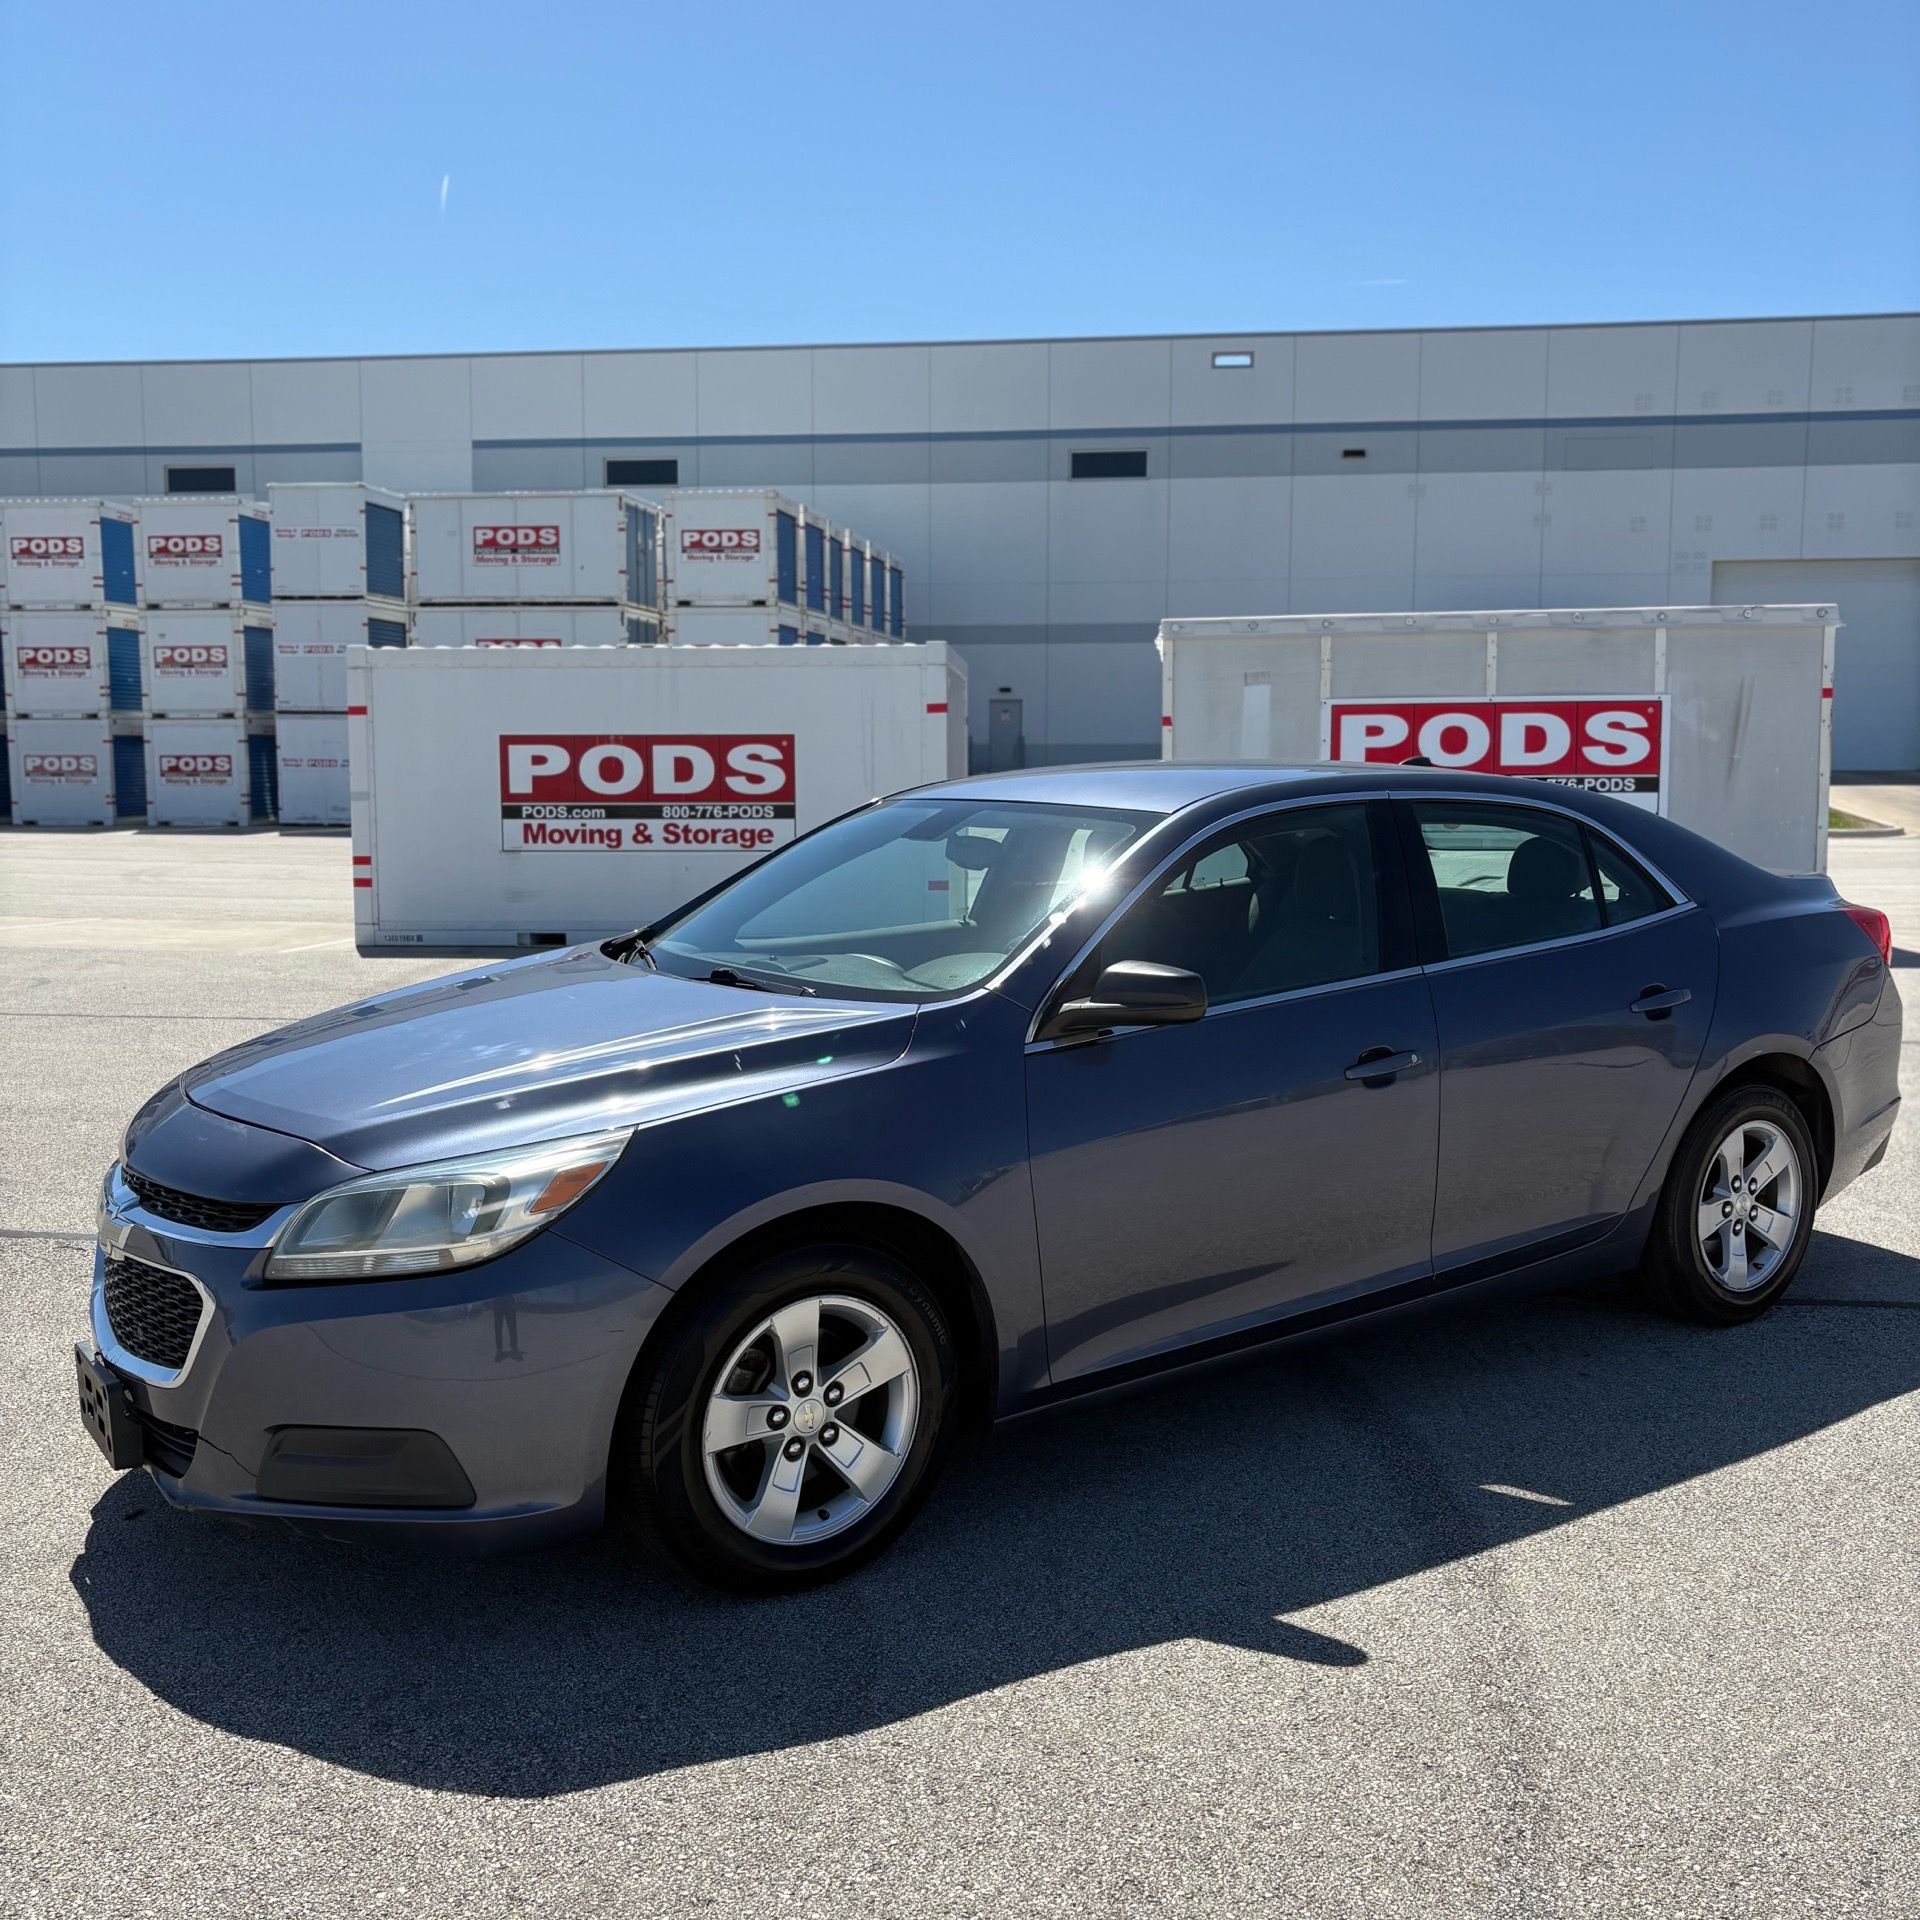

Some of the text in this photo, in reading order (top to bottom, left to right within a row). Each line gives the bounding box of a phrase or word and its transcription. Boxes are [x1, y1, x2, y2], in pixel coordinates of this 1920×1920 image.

[475, 528, 557, 545] PODS
[684, 531, 758, 547] PODS
[12, 539, 82, 554] PODS
[149, 538, 221, 553] PODS
[476, 555, 509, 565] Moving
[521, 555, 557, 565] Storage
[19, 649, 89, 664] PODS
[155, 648, 226, 662] PODS
[1340, 711, 1651, 767] PODS
[26, 756, 95, 771] PODS
[161, 757, 230, 771] PODS
[508, 744, 787, 795] PODS
[522, 805, 774, 819] PODS.com 800-776-PODS
[522, 822, 774, 849] Moving & Storage
